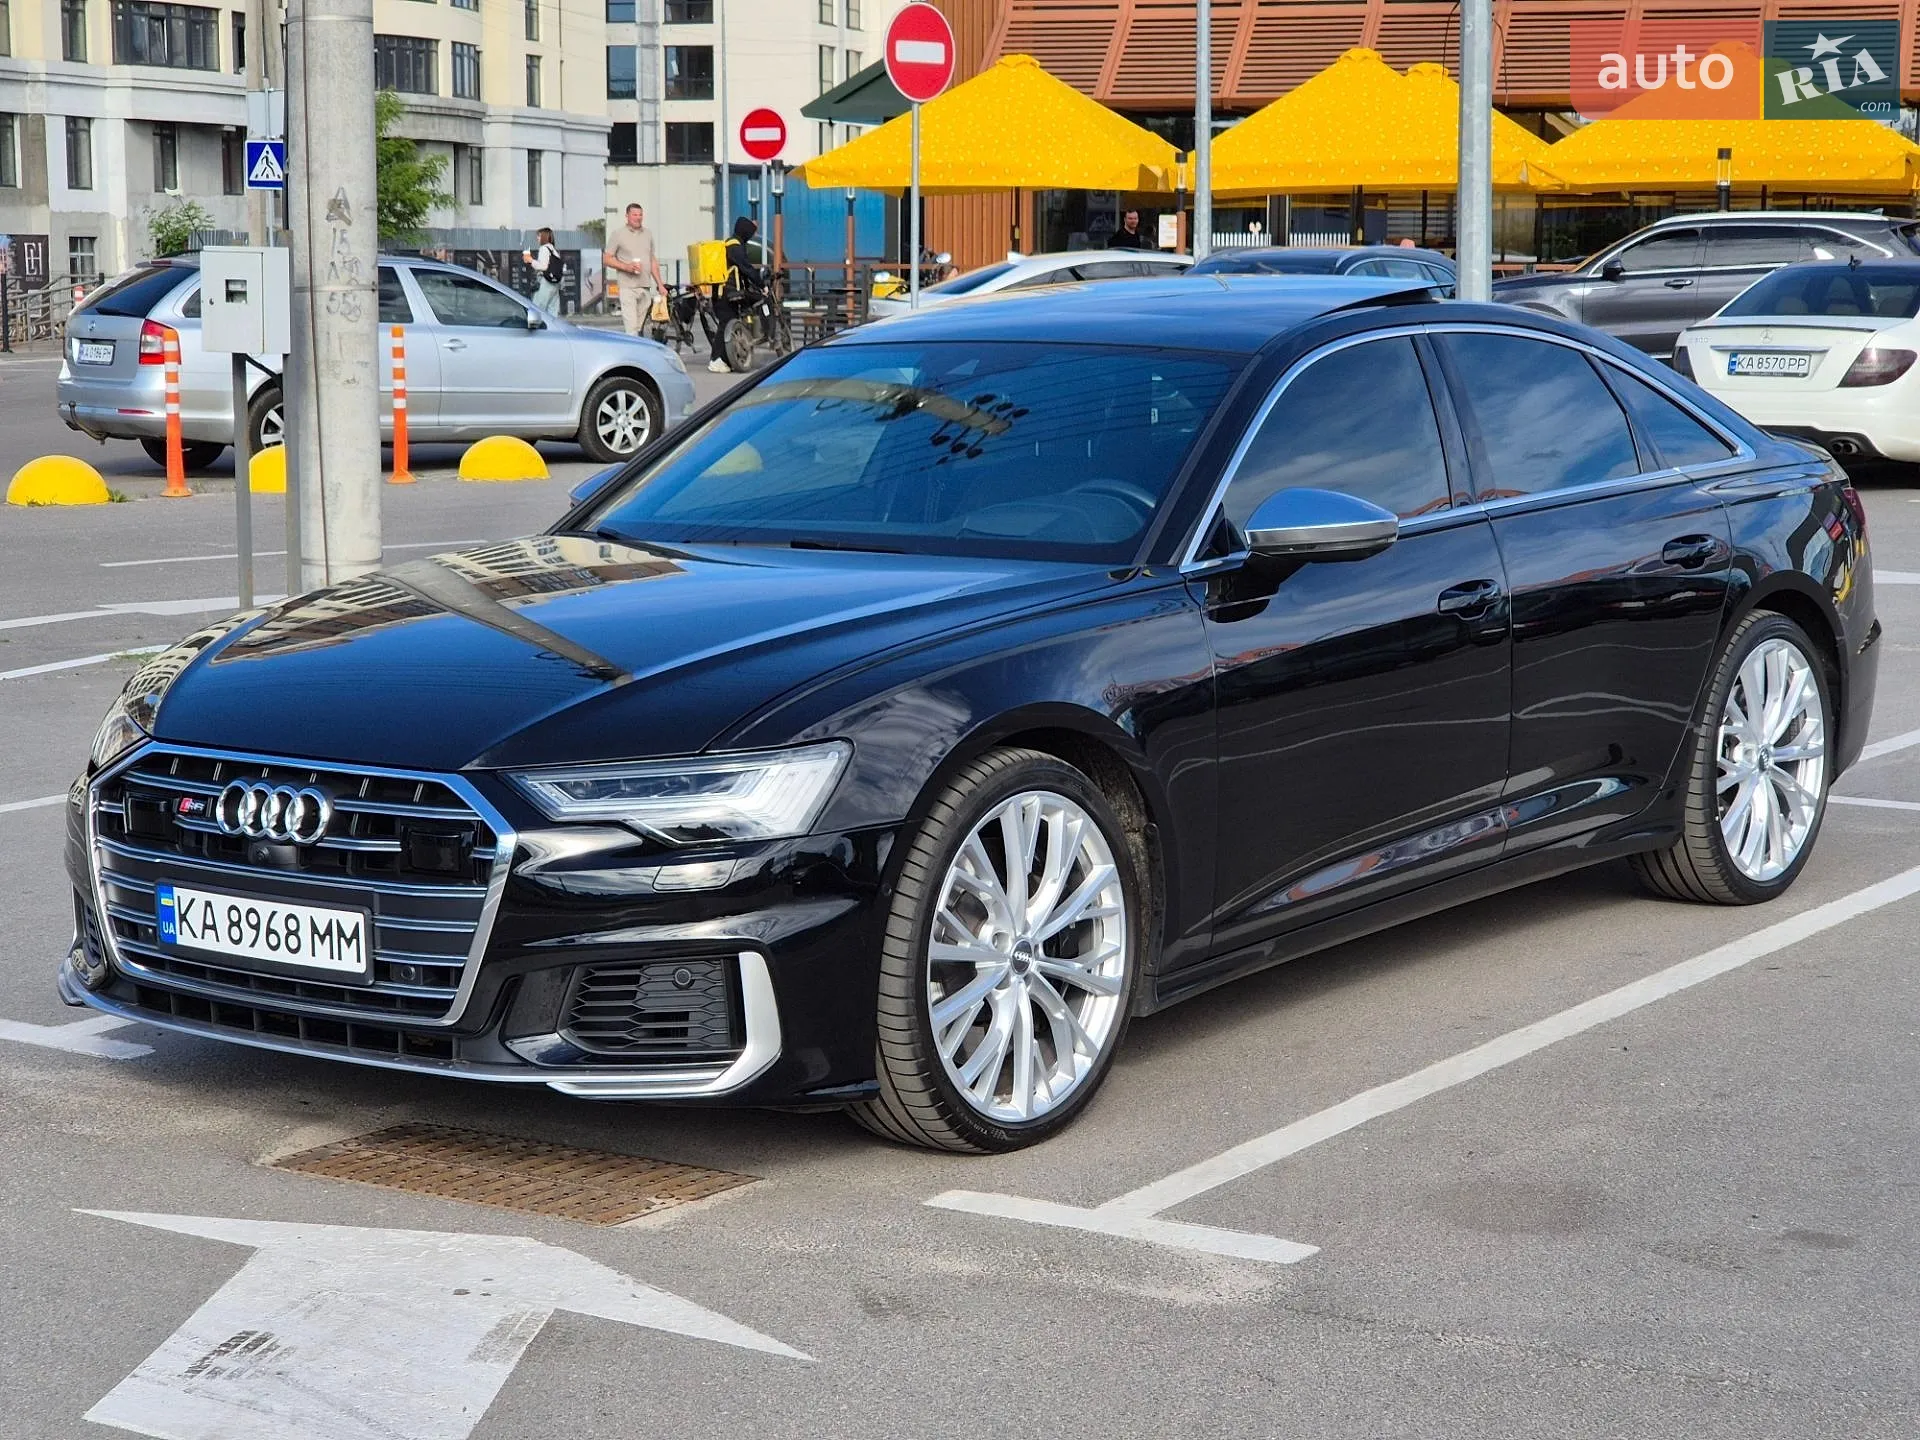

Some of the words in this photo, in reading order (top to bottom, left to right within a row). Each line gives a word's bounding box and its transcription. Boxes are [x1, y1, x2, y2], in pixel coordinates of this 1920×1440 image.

[1737, 357, 1754, 369] KA
[1756, 357, 1786, 370] 8570
[1788, 358, 1807, 371] PP
[162, 921, 175, 935] UA
[177, 895, 220, 943] KA
[226, 904, 301, 955] 8968
[310, 915, 362, 964] MM
